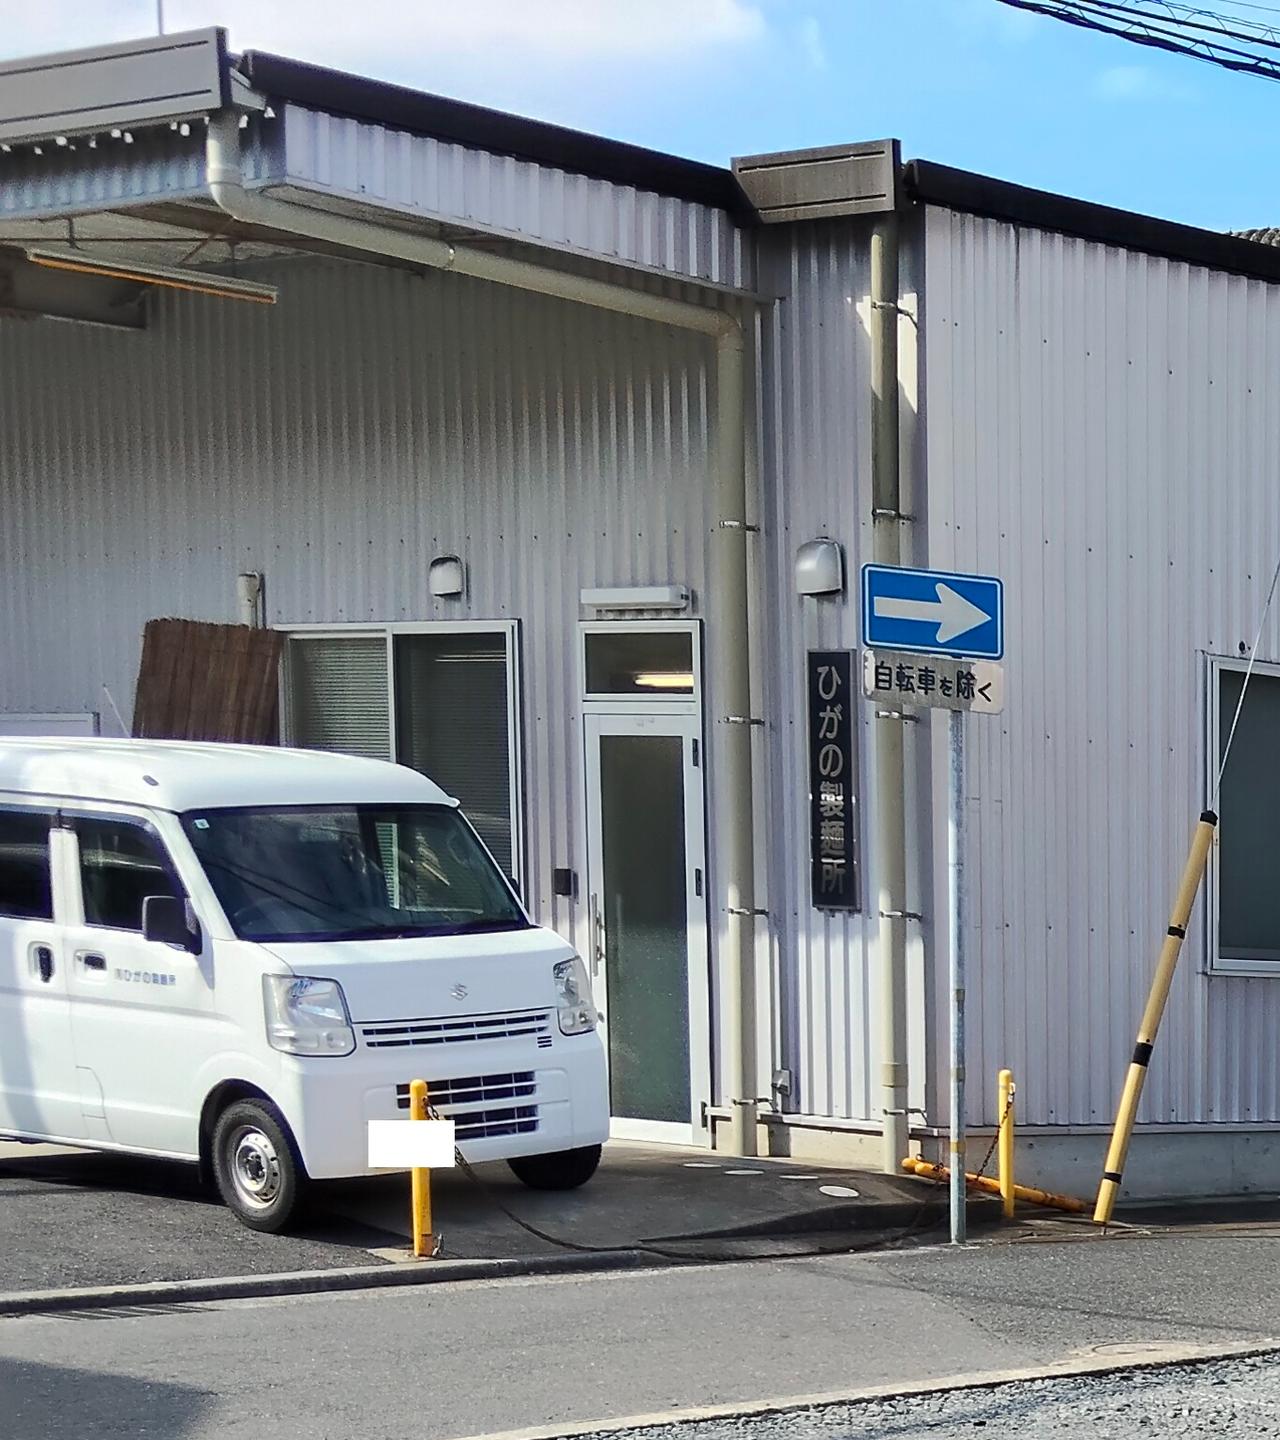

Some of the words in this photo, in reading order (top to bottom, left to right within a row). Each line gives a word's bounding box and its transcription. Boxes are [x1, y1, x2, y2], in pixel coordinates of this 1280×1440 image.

[874, 660, 992, 703] 自転車を除く
[817, 665, 846, 894] ひがの製麺所
